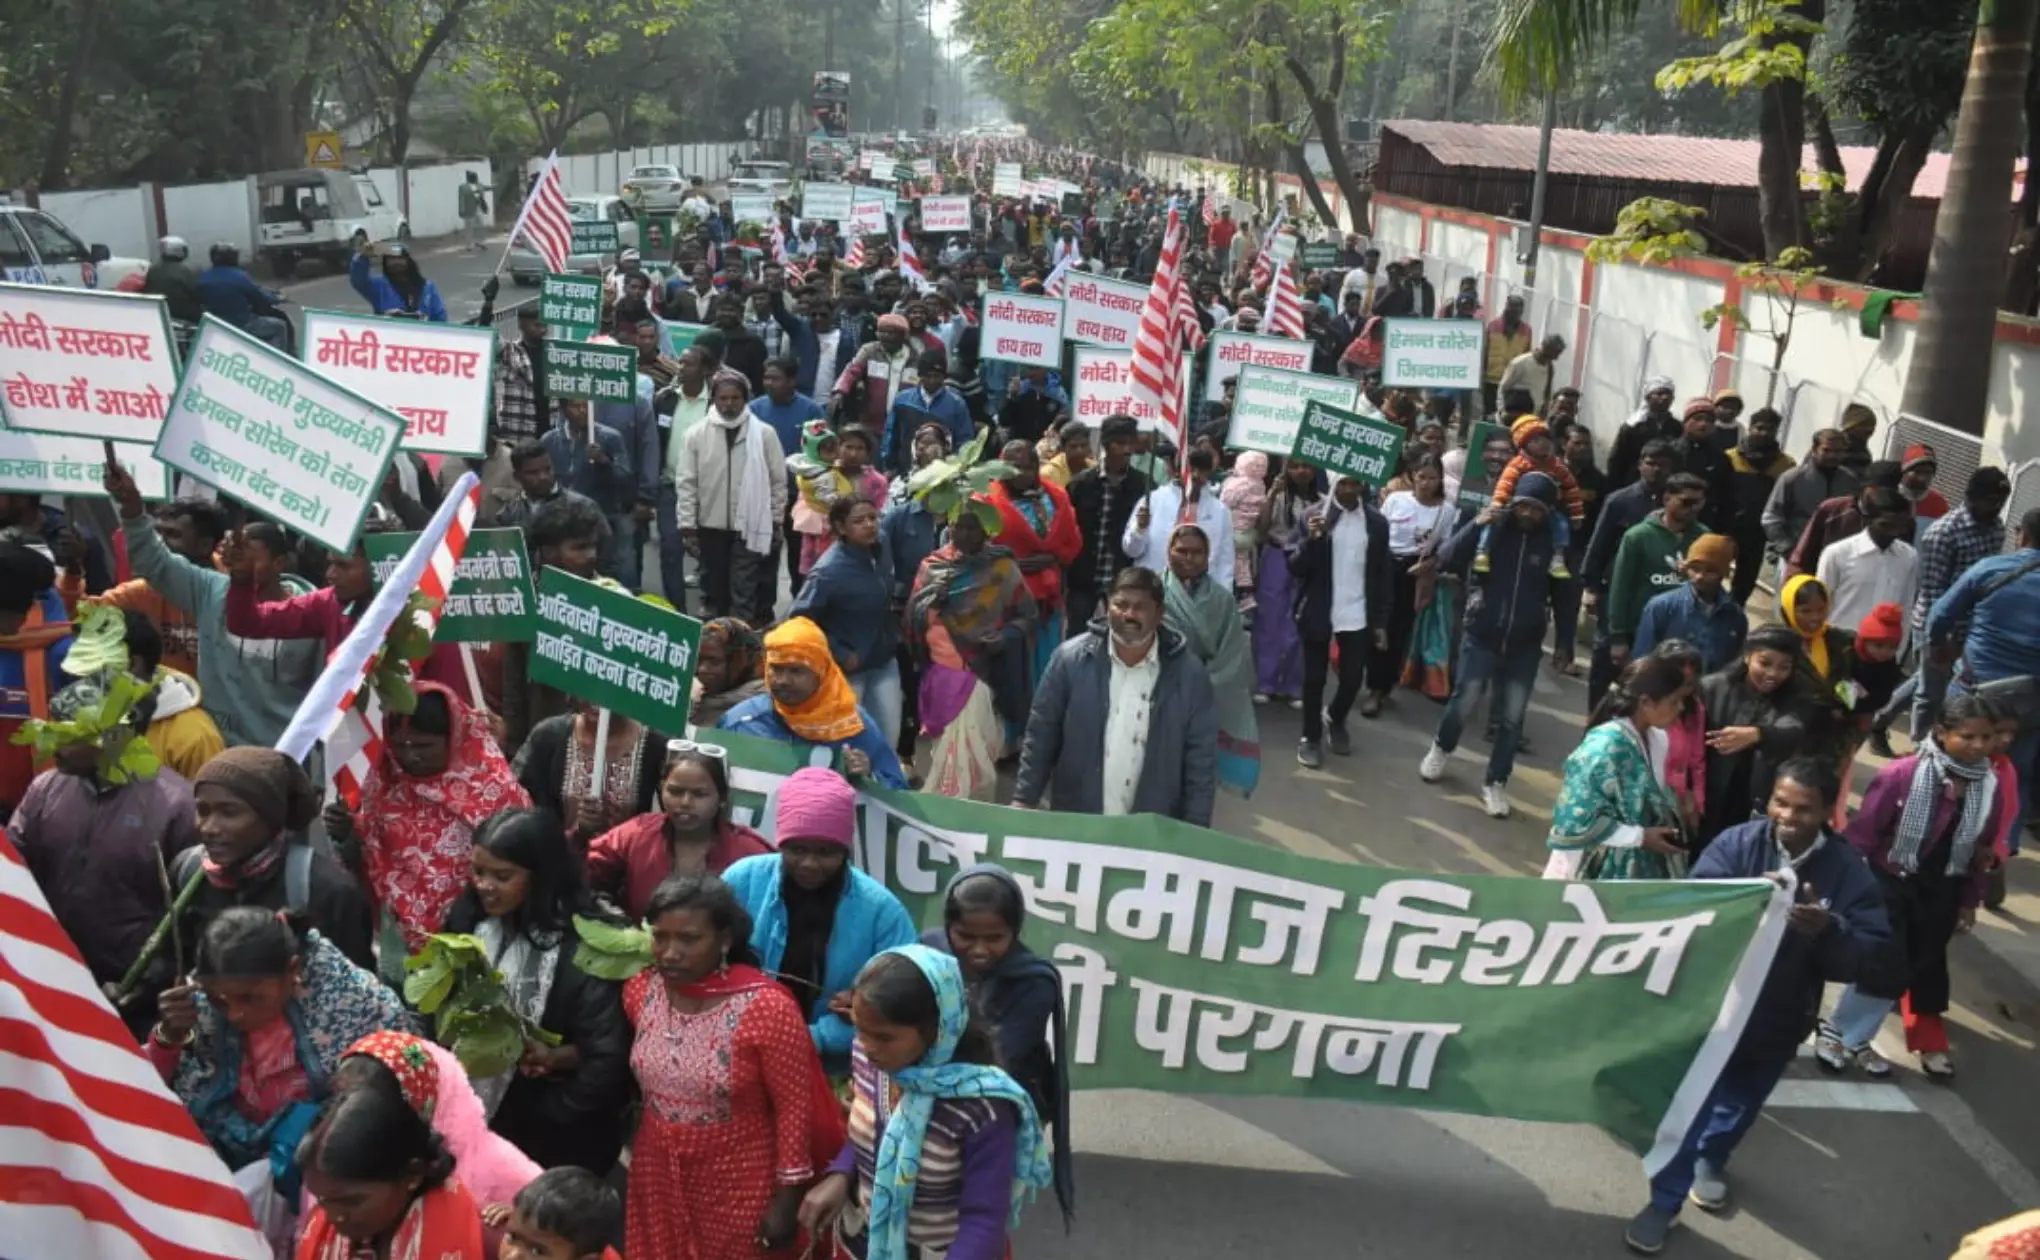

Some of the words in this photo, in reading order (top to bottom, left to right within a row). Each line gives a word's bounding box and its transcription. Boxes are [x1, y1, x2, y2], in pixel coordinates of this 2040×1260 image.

[989, 300, 1015, 322] मोदी
[1016, 308, 1057, 328] सरकार
[1069, 283, 1097, 304] मोदी
[1100, 291, 1144, 315] सरकार
[52, 326, 152, 361] सरकार
[317, 328, 380, 370] मोदी
[385, 344, 481, 379] सरकार
[1218, 341, 1251, 361] मोदी
[1254, 350, 1306, 369] सरकार
[1080, 360, 1117, 382] मोदी
[3, 371, 60, 409] होश
[63, 375, 89, 412] में
[200, 347, 295, 408] आदिवासी
[293, 395, 386, 456] मुख्यमंत्री
[1078, 393, 1112, 415] होश
[182, 385, 245, 433] हेमन्त
[245, 419, 301, 462] सोरेन
[299, 449, 331, 478] को
[330, 462, 369, 498] तंग
[1342, 420, 1397, 452] सरकार
[52, 454, 82, 480] बंद
[190, 441, 247, 484] करना
[247, 468, 281, 500] बंद
[500, 549, 523, 580] को
[472, 590, 495, 615] बंद
[495, 586, 525, 615] करो
[536, 592, 600, 637] आदिवासी
[600, 618, 667, 663] मुख्यमंत्री
[668, 639, 691, 671] को
[536, 630, 584, 672] प्रताड़ित
[583, 651, 627, 687] करना
[626, 662, 650, 695] बंद
[649, 675, 681, 707] करो
[1003, 835, 1345, 976] समाज
[1358, 879, 1717, 996] दिशोम
[1130, 975, 1461, 1090] परगना
